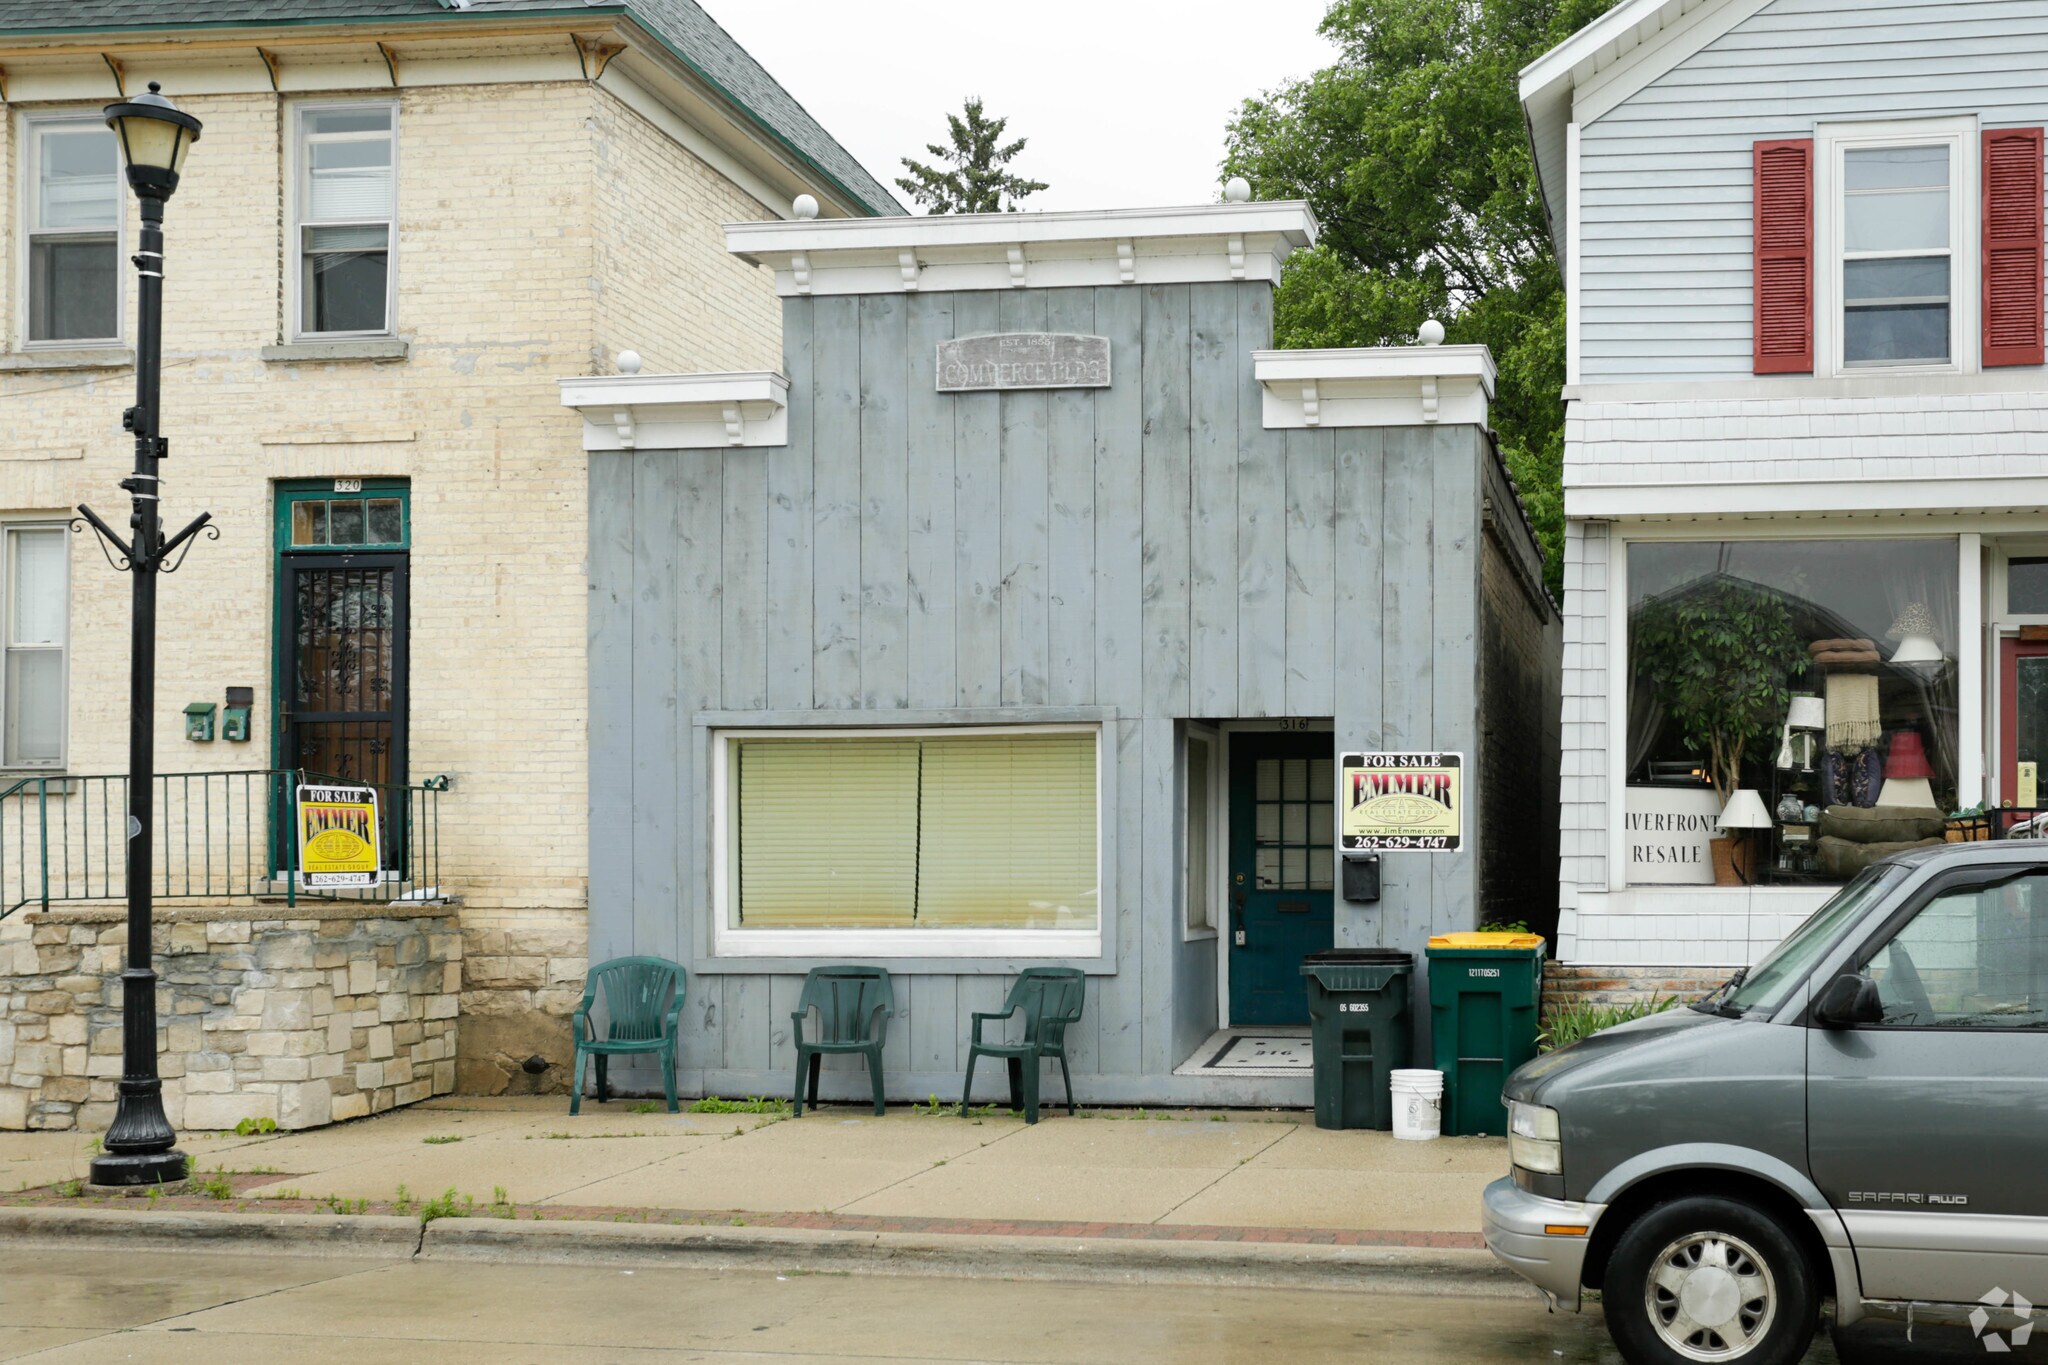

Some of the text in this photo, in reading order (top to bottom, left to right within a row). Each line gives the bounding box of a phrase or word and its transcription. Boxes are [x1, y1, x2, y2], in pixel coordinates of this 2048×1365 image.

[945, 362, 1046, 384] COMMERCE
[336, 480, 361, 491] 320
[1282, 719, 1306, 730] 316
[1363, 755, 1441, 767] FOR SALE
[310, 790, 362, 803] FOR SALE
[1351, 773, 1453, 812] EMMER
[305, 807, 371, 846] EMMER
[1625, 812, 1721, 833] IVERFRONT
[1358, 827, 1445, 835] www.JimEmmer.com
[1354, 836, 1448, 848] 262-629-4747
[1633, 845, 1702, 864] RESALE
[347, 863, 369, 871] GROUP
[315, 874, 367, 884] 262-629-4747
[1848, 1191, 1968, 1205] SAFARI AWD
